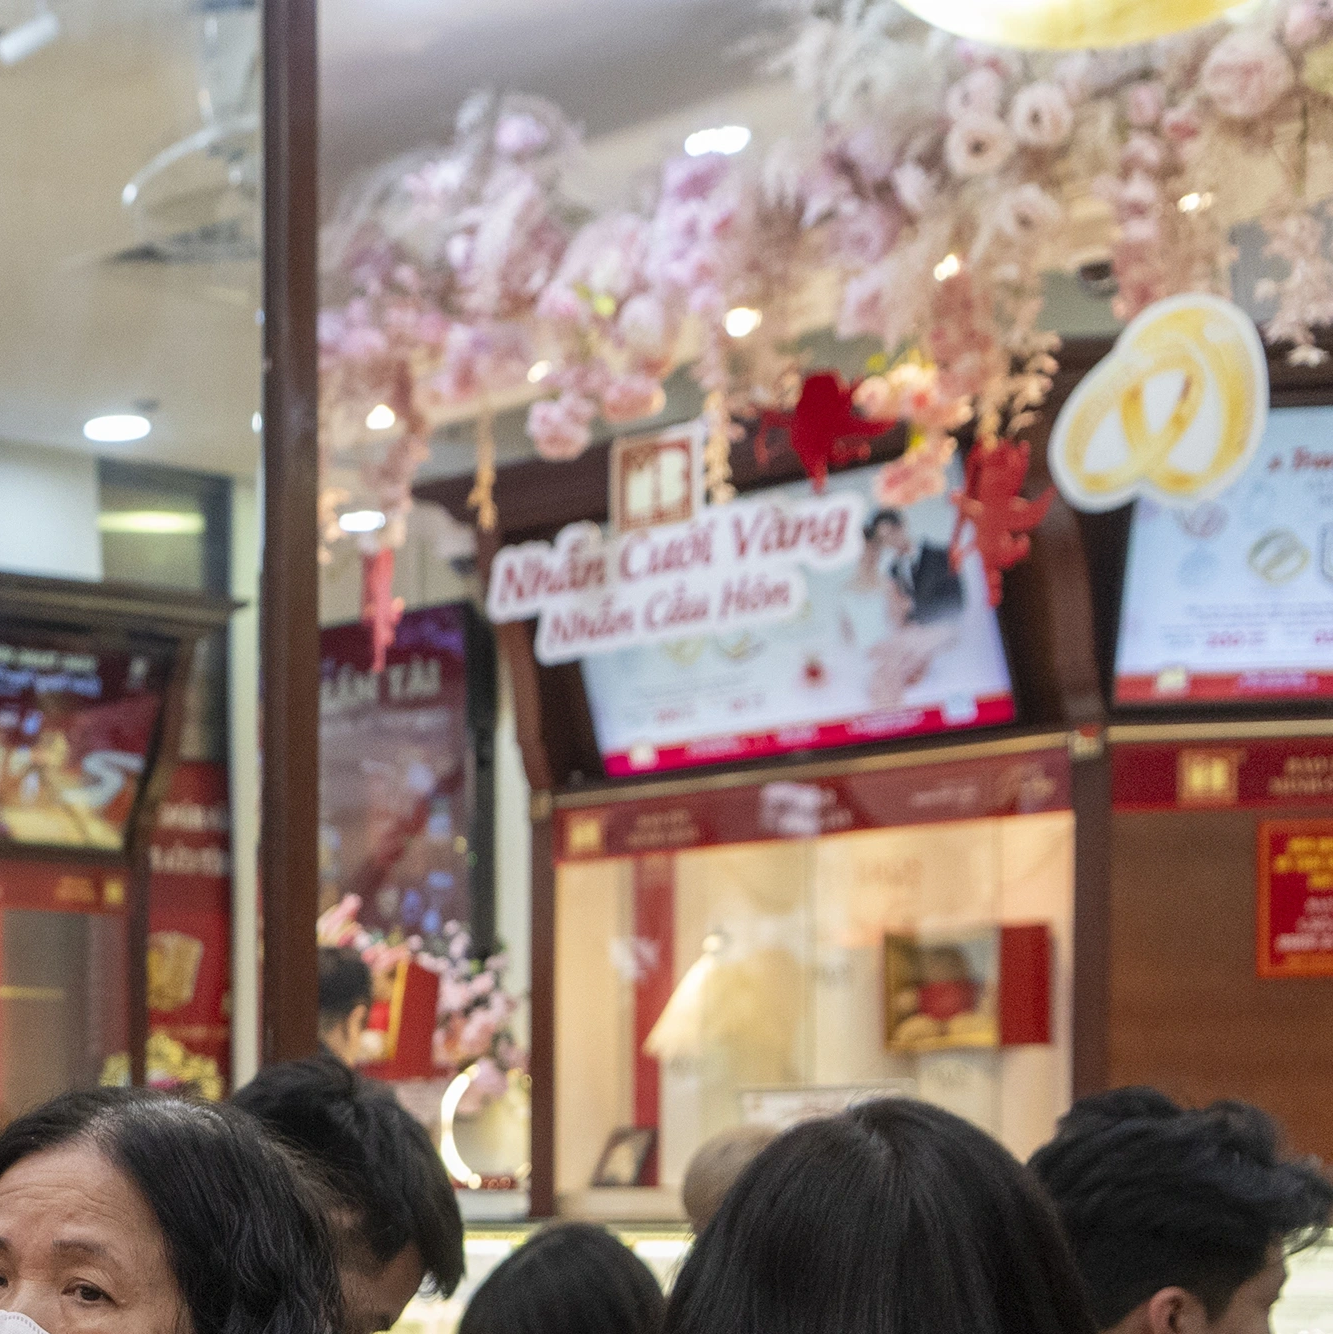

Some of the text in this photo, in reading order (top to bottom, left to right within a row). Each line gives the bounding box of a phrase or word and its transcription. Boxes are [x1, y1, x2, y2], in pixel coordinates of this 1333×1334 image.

[497, 506, 851, 606] Nhẫn Cưới Vàng
